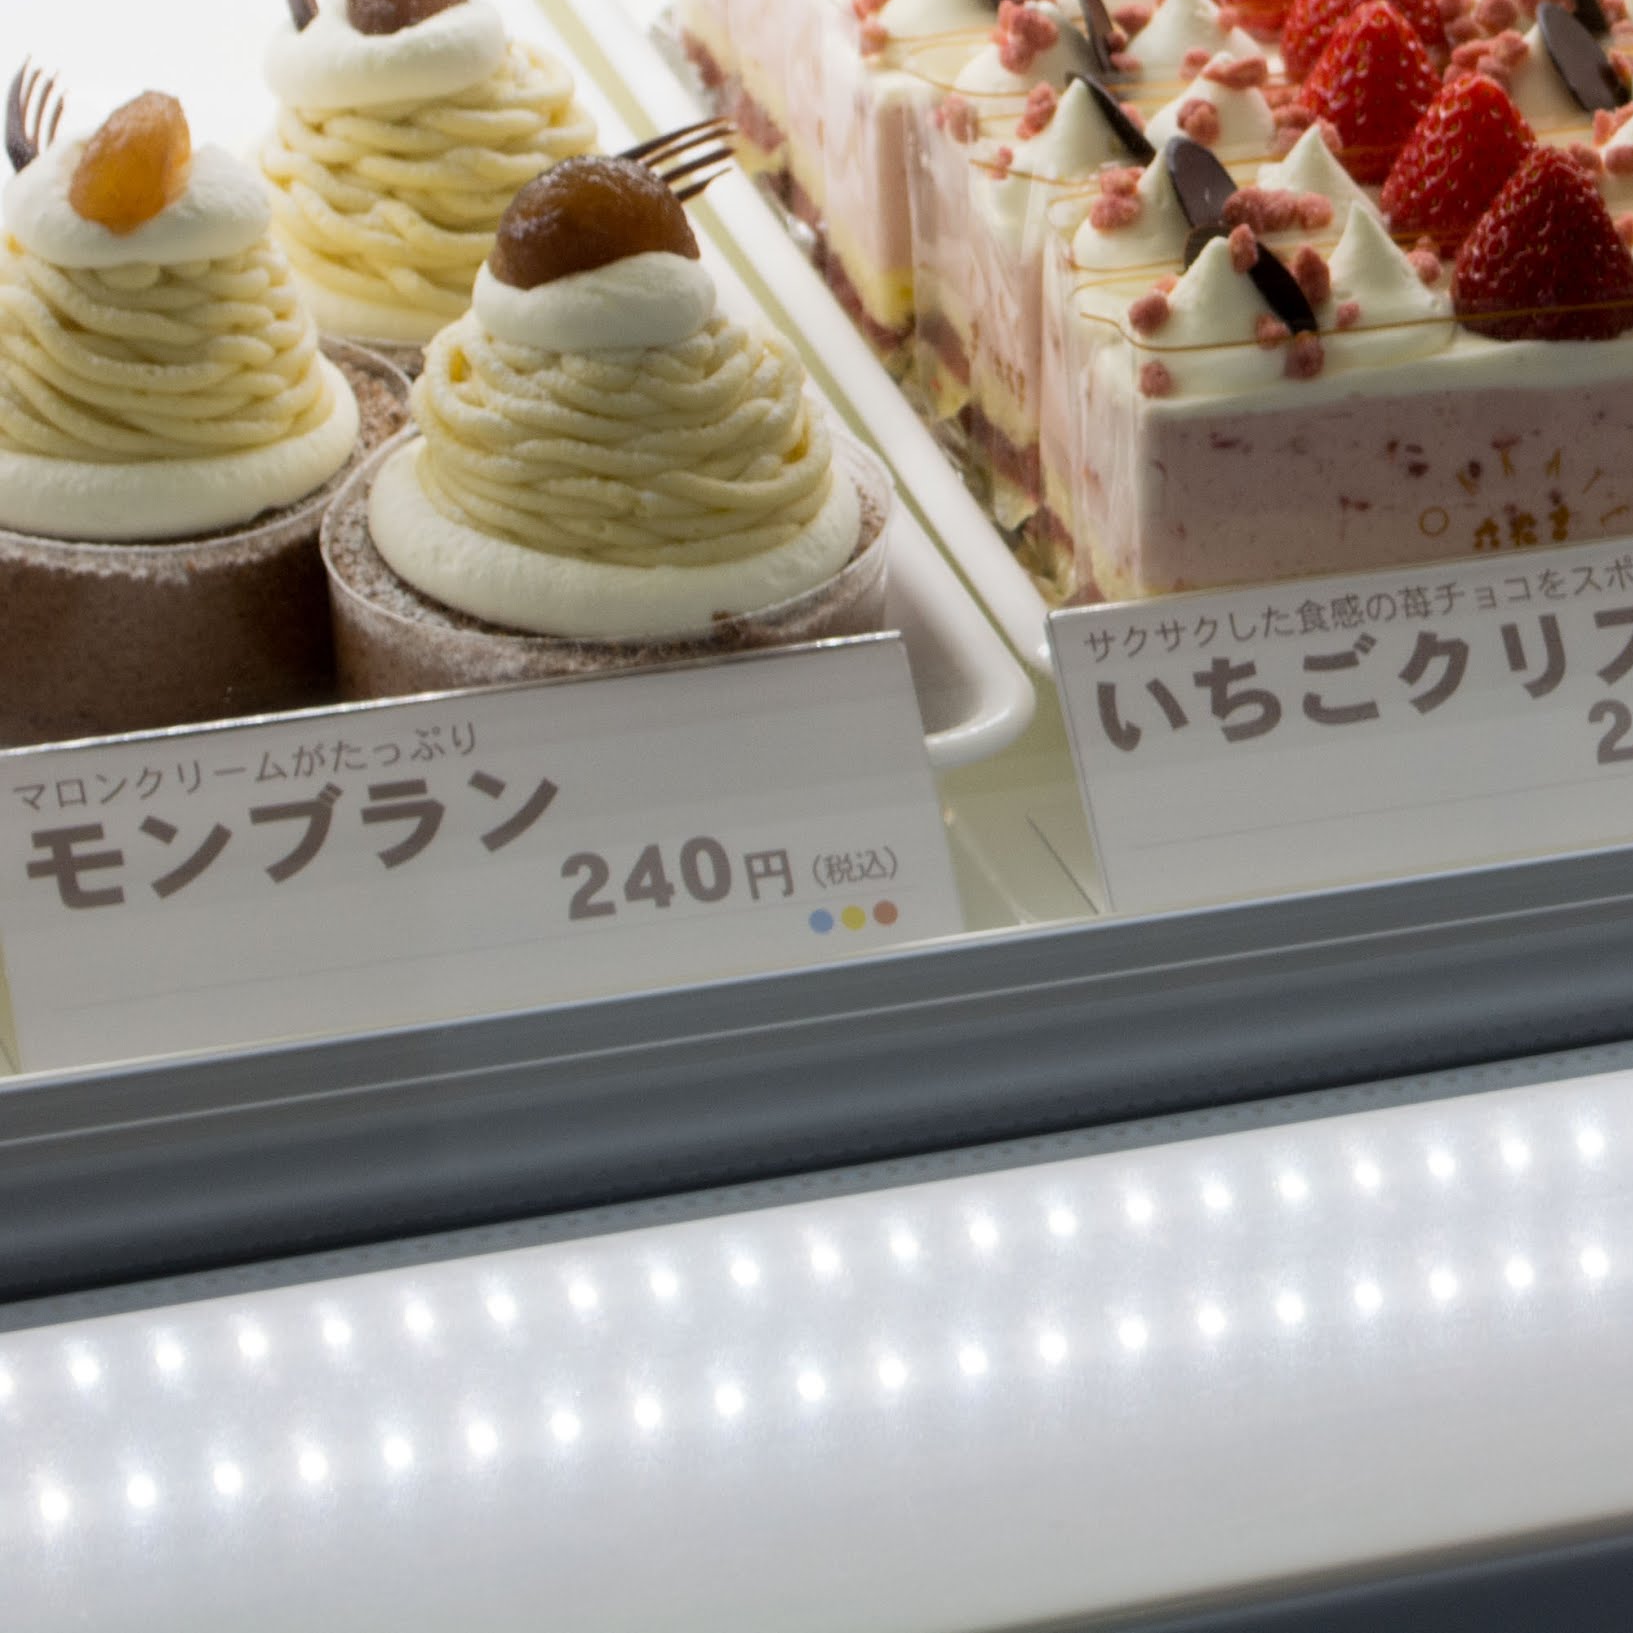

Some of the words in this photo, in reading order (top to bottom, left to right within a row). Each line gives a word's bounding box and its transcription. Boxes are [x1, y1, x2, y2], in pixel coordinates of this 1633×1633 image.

[13, 722, 478, 812] マロンクリームがたっぷり
[26, 771, 558, 910] モンブラン
[561, 836, 794, 921] 240円
